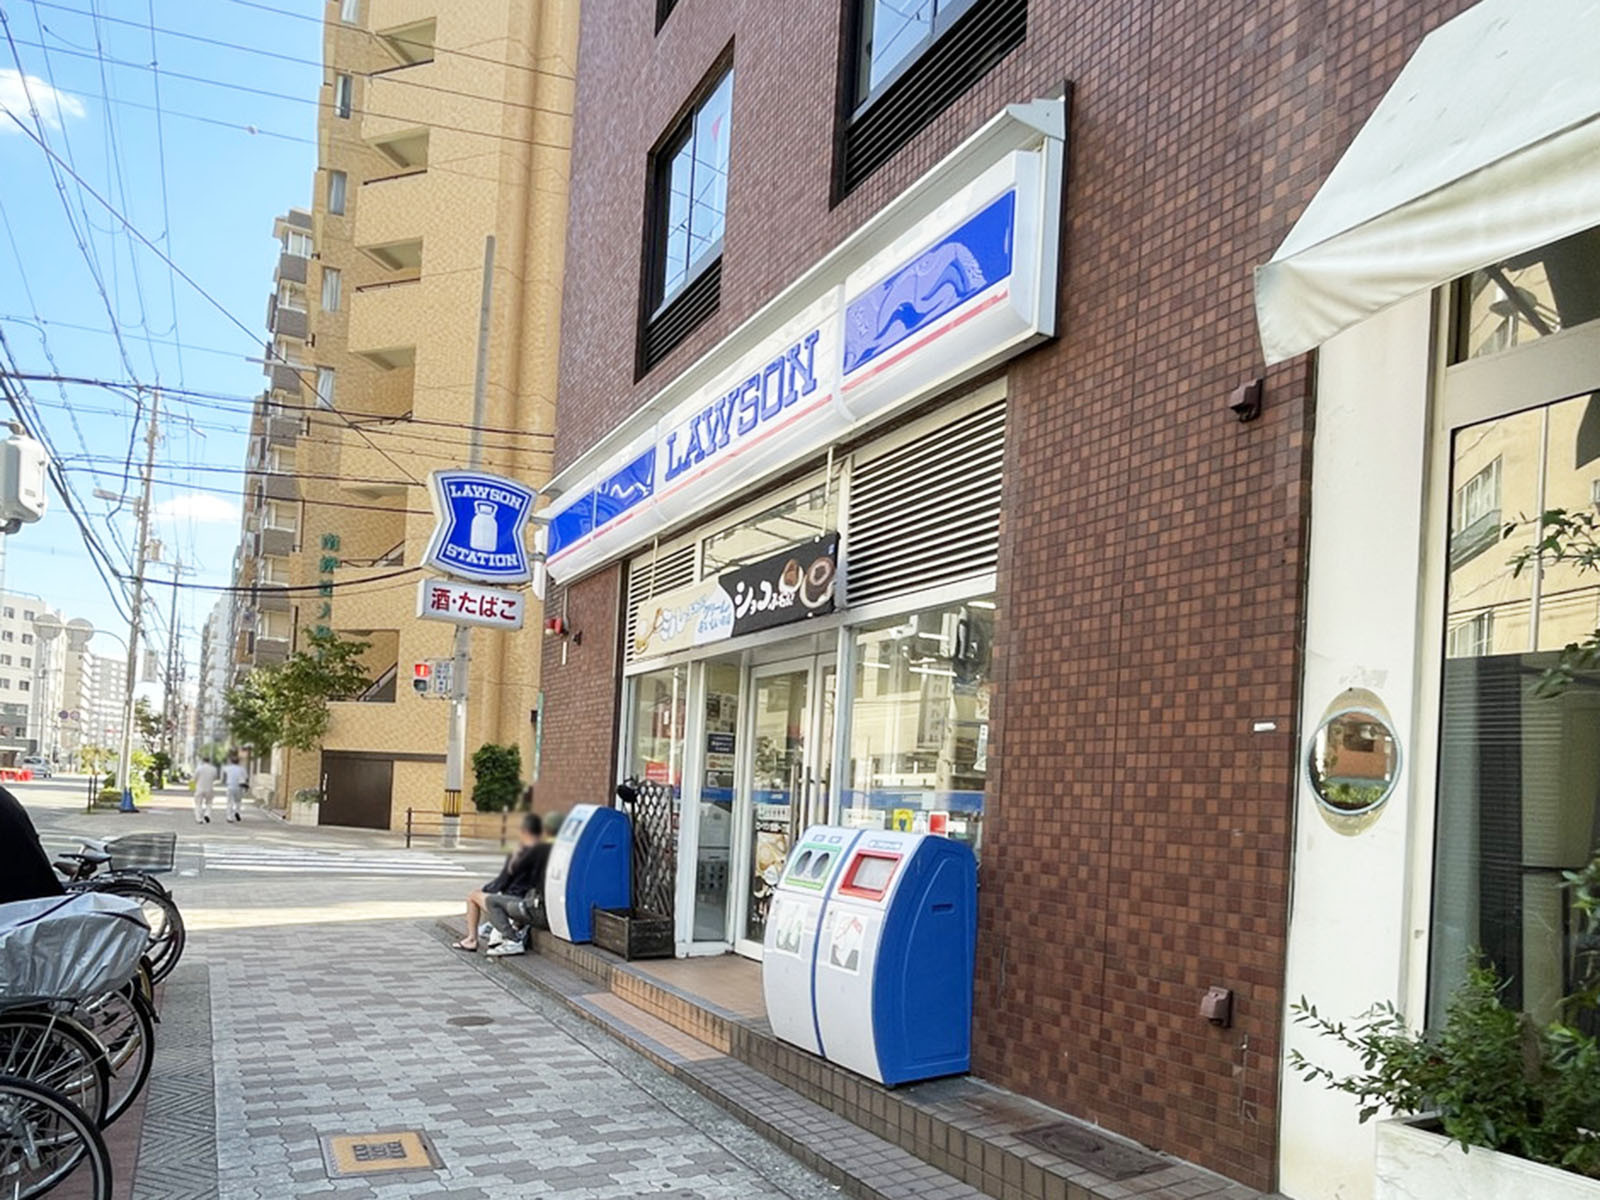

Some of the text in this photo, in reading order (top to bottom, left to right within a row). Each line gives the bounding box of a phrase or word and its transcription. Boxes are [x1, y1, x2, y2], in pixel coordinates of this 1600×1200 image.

[665, 329, 820, 481] LAWSON
[451, 485, 521, 509] LAWSON
[447, 544, 518, 566] STATION
[431, 587, 516, 620] 酒・たばこ
